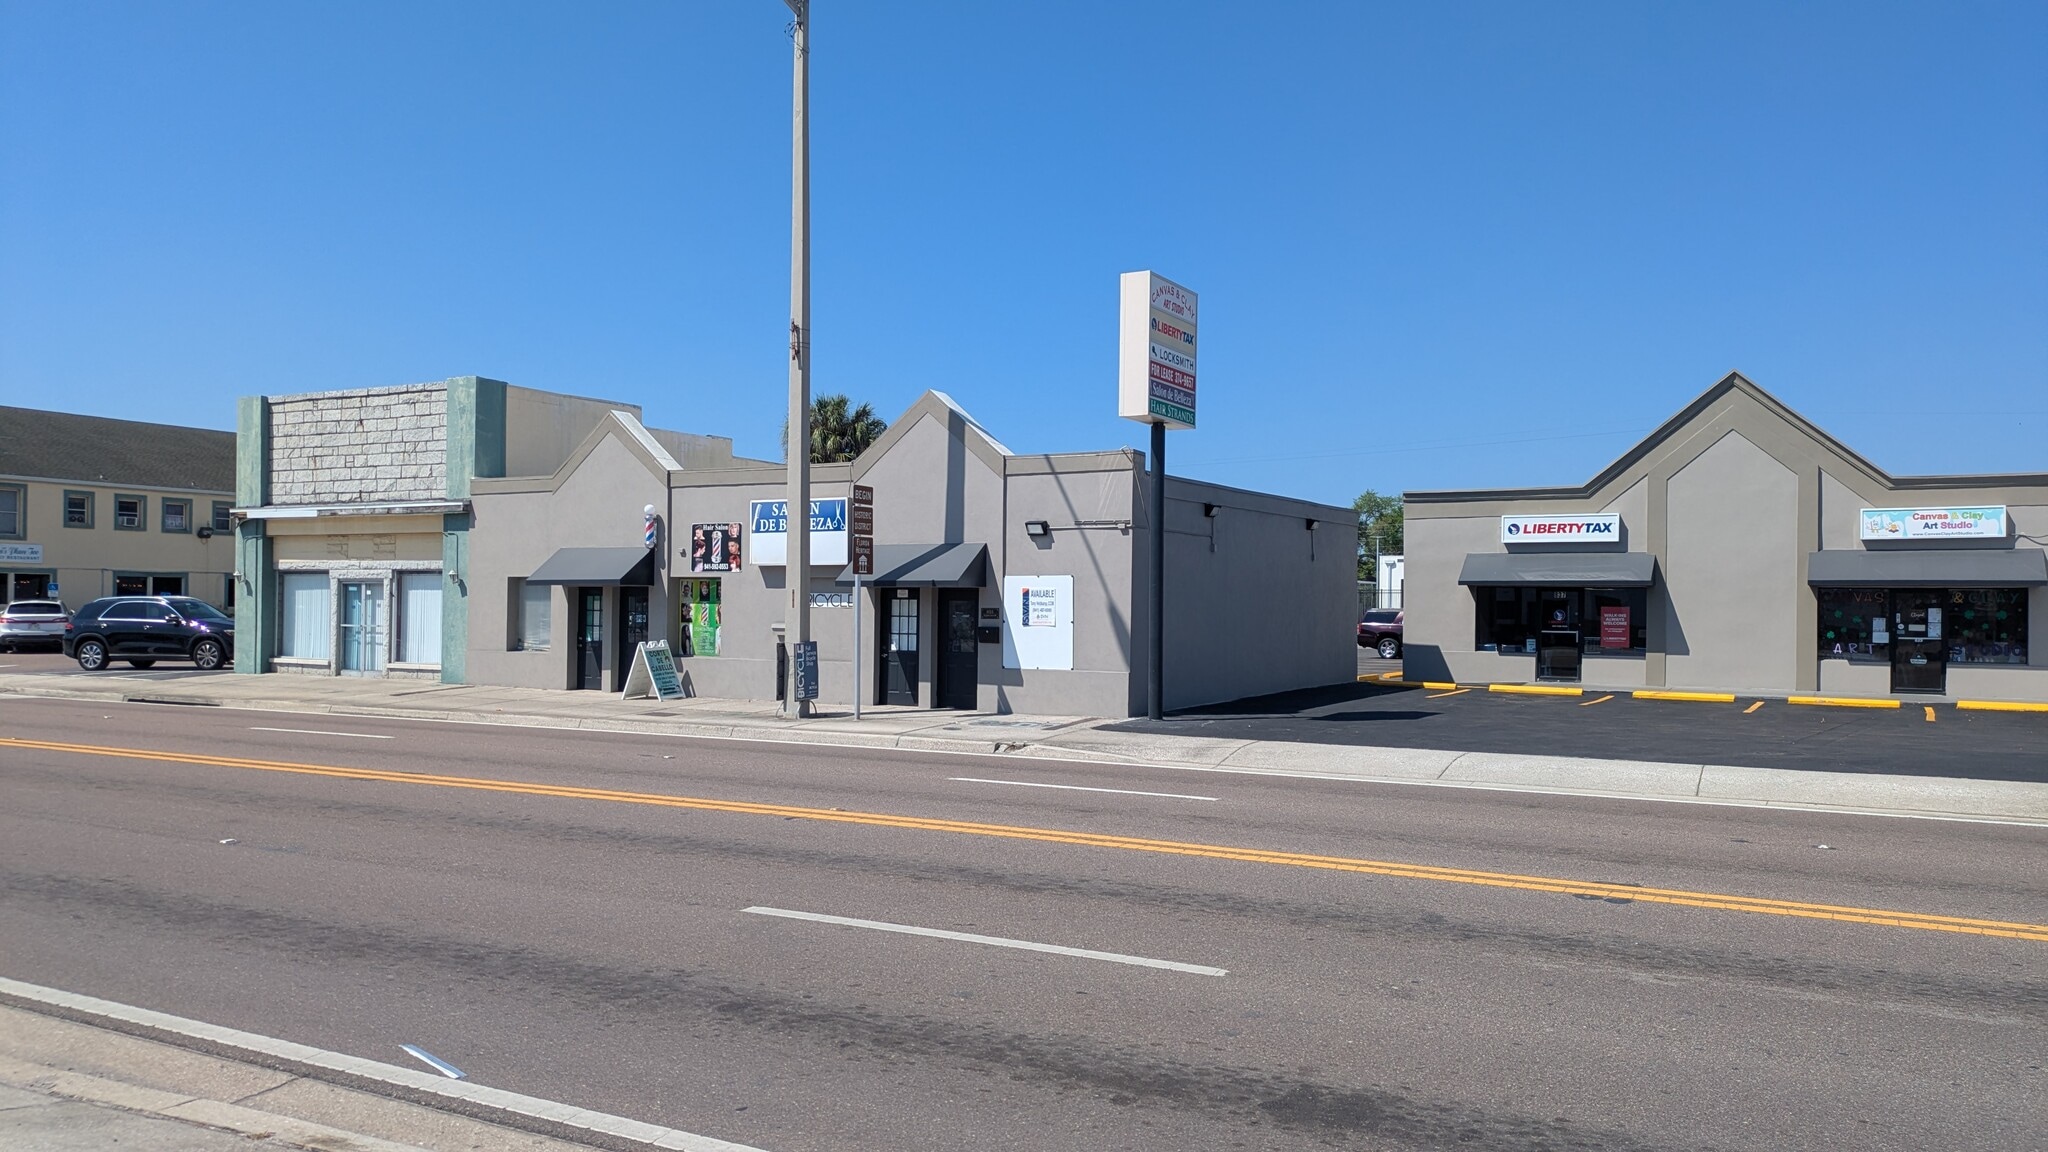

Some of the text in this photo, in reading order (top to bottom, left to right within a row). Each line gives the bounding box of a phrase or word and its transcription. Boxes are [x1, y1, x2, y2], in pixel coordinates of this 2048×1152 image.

[1152, 286, 1195, 318] CANVAS & CLAY
[1163, 299, 1184, 316] ART STUDIO
[1160, 349, 1194, 370] LOCKSMITH
[1151, 363, 1160, 377] FOR
[1160, 366, 1174, 382] LEASE
[1153, 382, 1167, 398] Salon
[1167, 387, 1173, 400] de
[1151, 399, 1194, 423] HAIR STRANDS
[855, 490, 871, 500] BEGIN
[772, 502, 821, 516] SAN
[1961, 511, 1984, 520] Clay
[760, 517, 834, 532] DE BEZA
[855, 522, 871, 531] DISTRICT
[1940, 521, 1973, 529] Studio
[1031, 589, 1055, 598] AVAILABLE
[1833, 643, 1874, 655] ART
[651, 664, 674, 672] CABELLO
[797, 645, 805, 699] BICYCLE
